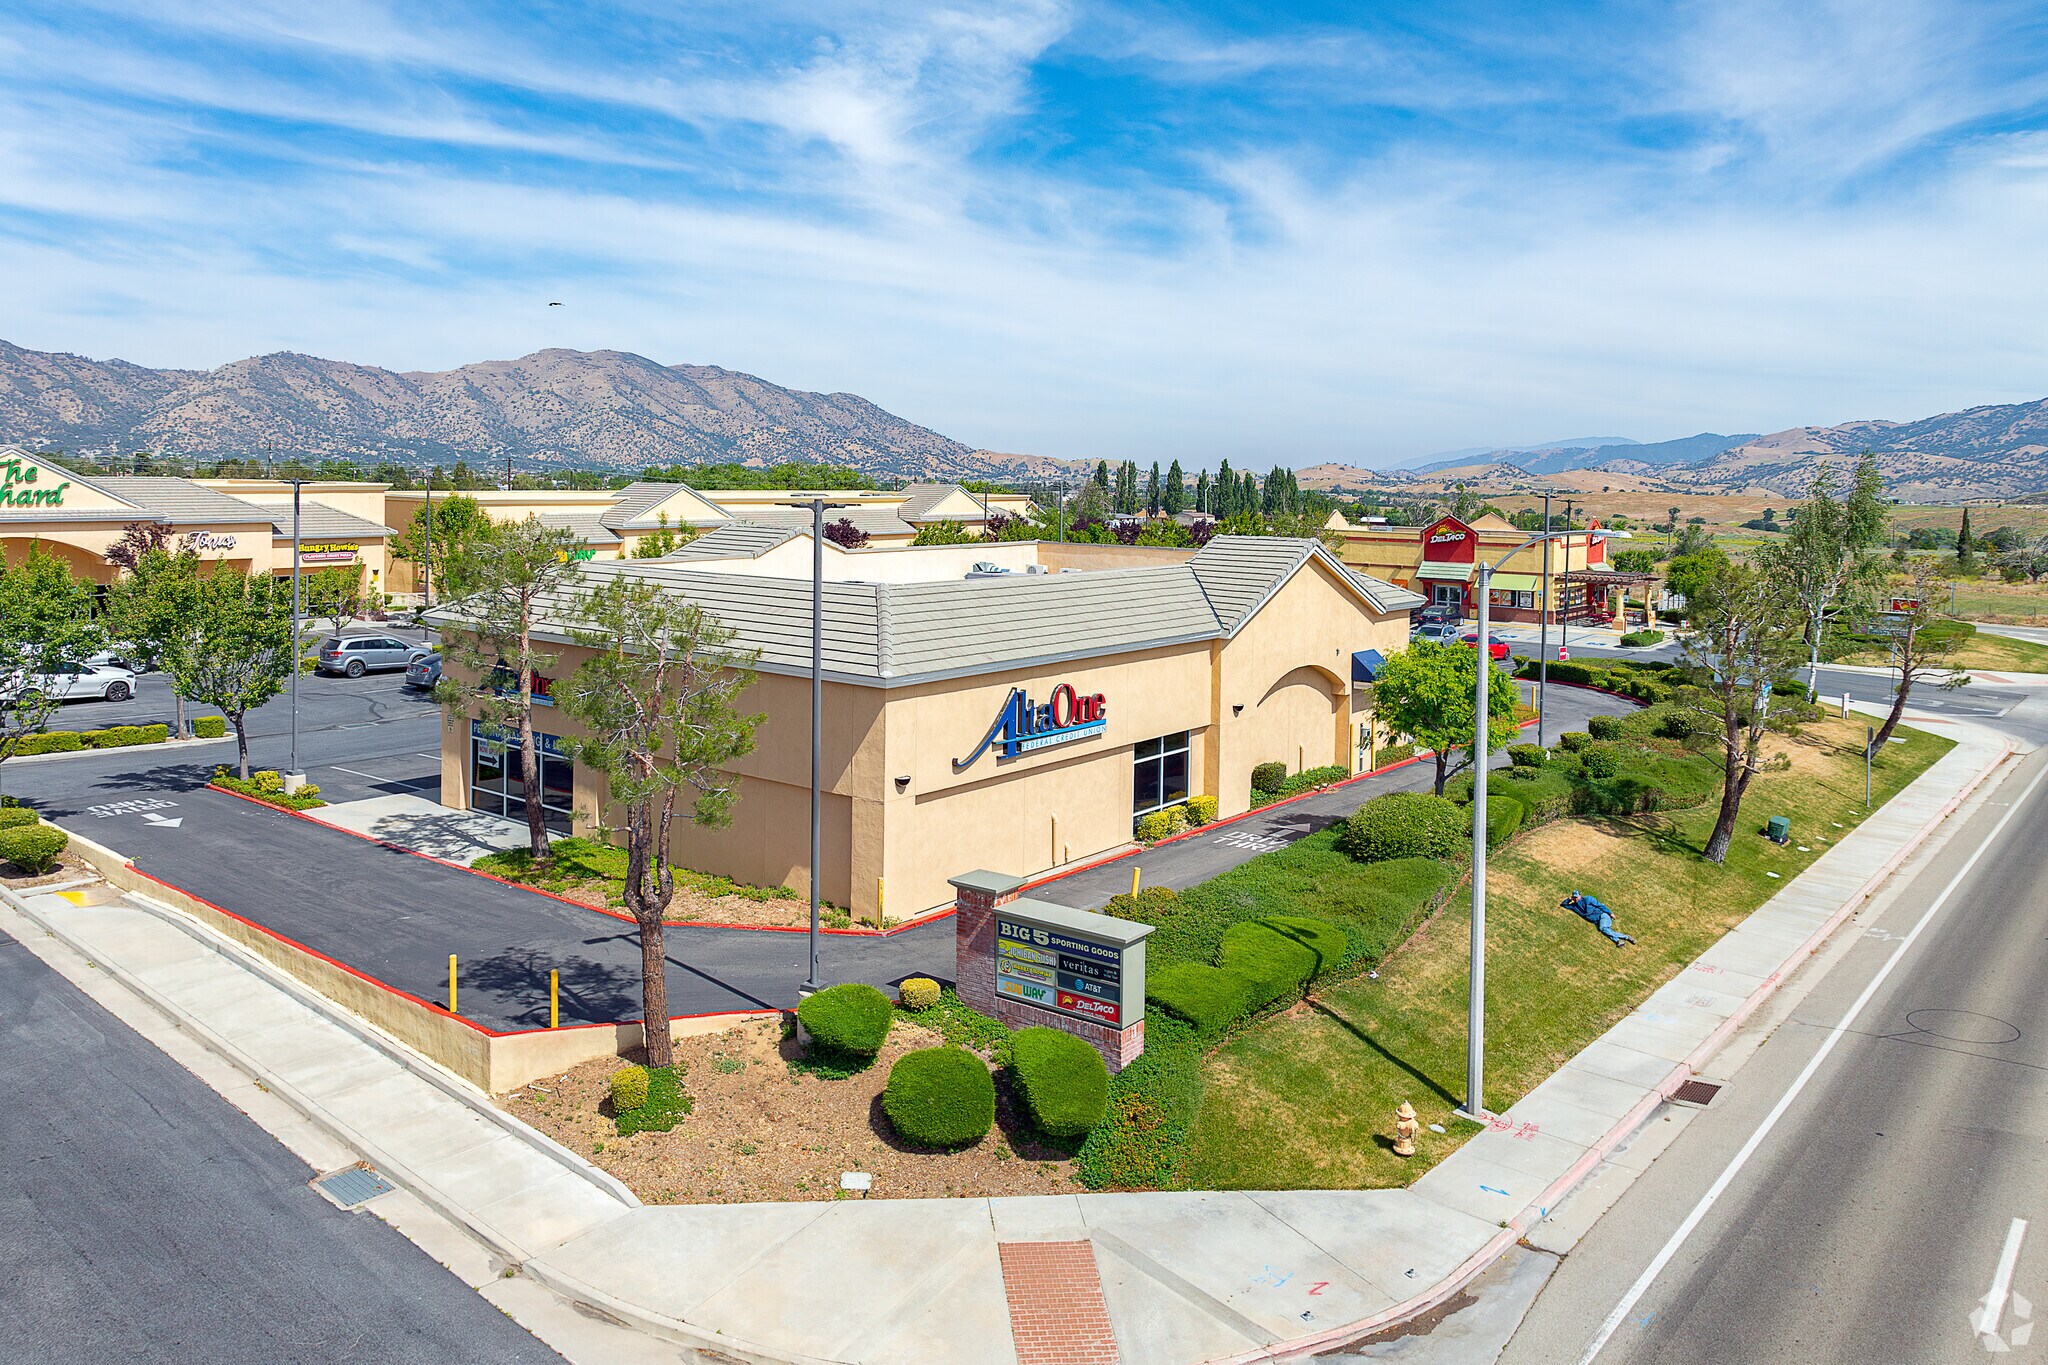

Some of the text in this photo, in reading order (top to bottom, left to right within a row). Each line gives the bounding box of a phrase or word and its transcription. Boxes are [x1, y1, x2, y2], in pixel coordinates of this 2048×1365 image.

[952, 683, 1107, 768] AltaOne
[1021, 724, 1107, 750] FEDERAL CREDIT UNION
[1224, 830, 1290, 849] DRIV
[1000, 922, 1119, 960] BIG 5 SPORTING GOODS
[1003, 980, 1047, 1000] SUBWAY
[1084, 983, 1102, 994] AT&T
